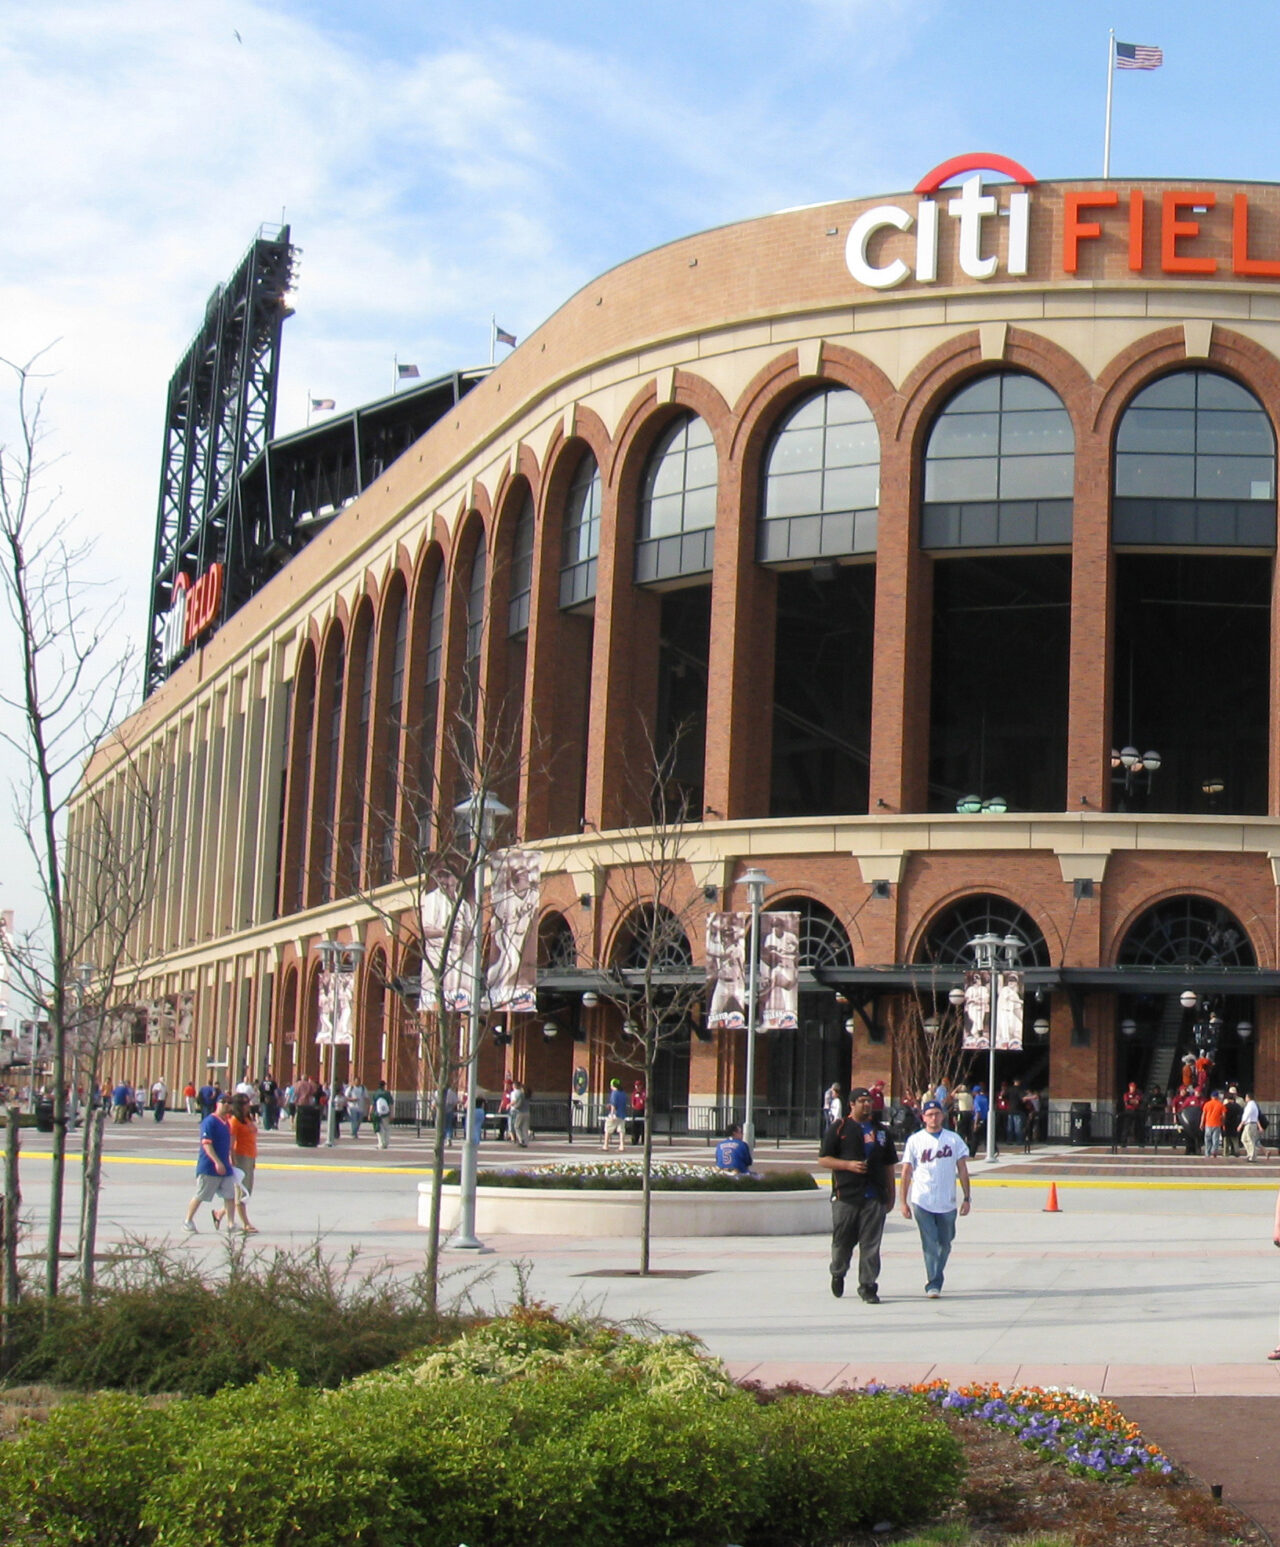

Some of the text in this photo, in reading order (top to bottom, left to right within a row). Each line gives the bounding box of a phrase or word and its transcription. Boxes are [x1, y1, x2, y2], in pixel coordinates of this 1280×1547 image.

[845, 174, 1029, 289] citi
[722, 1148, 732, 1165] 5
[921, 1144, 953, 1163] Mets
